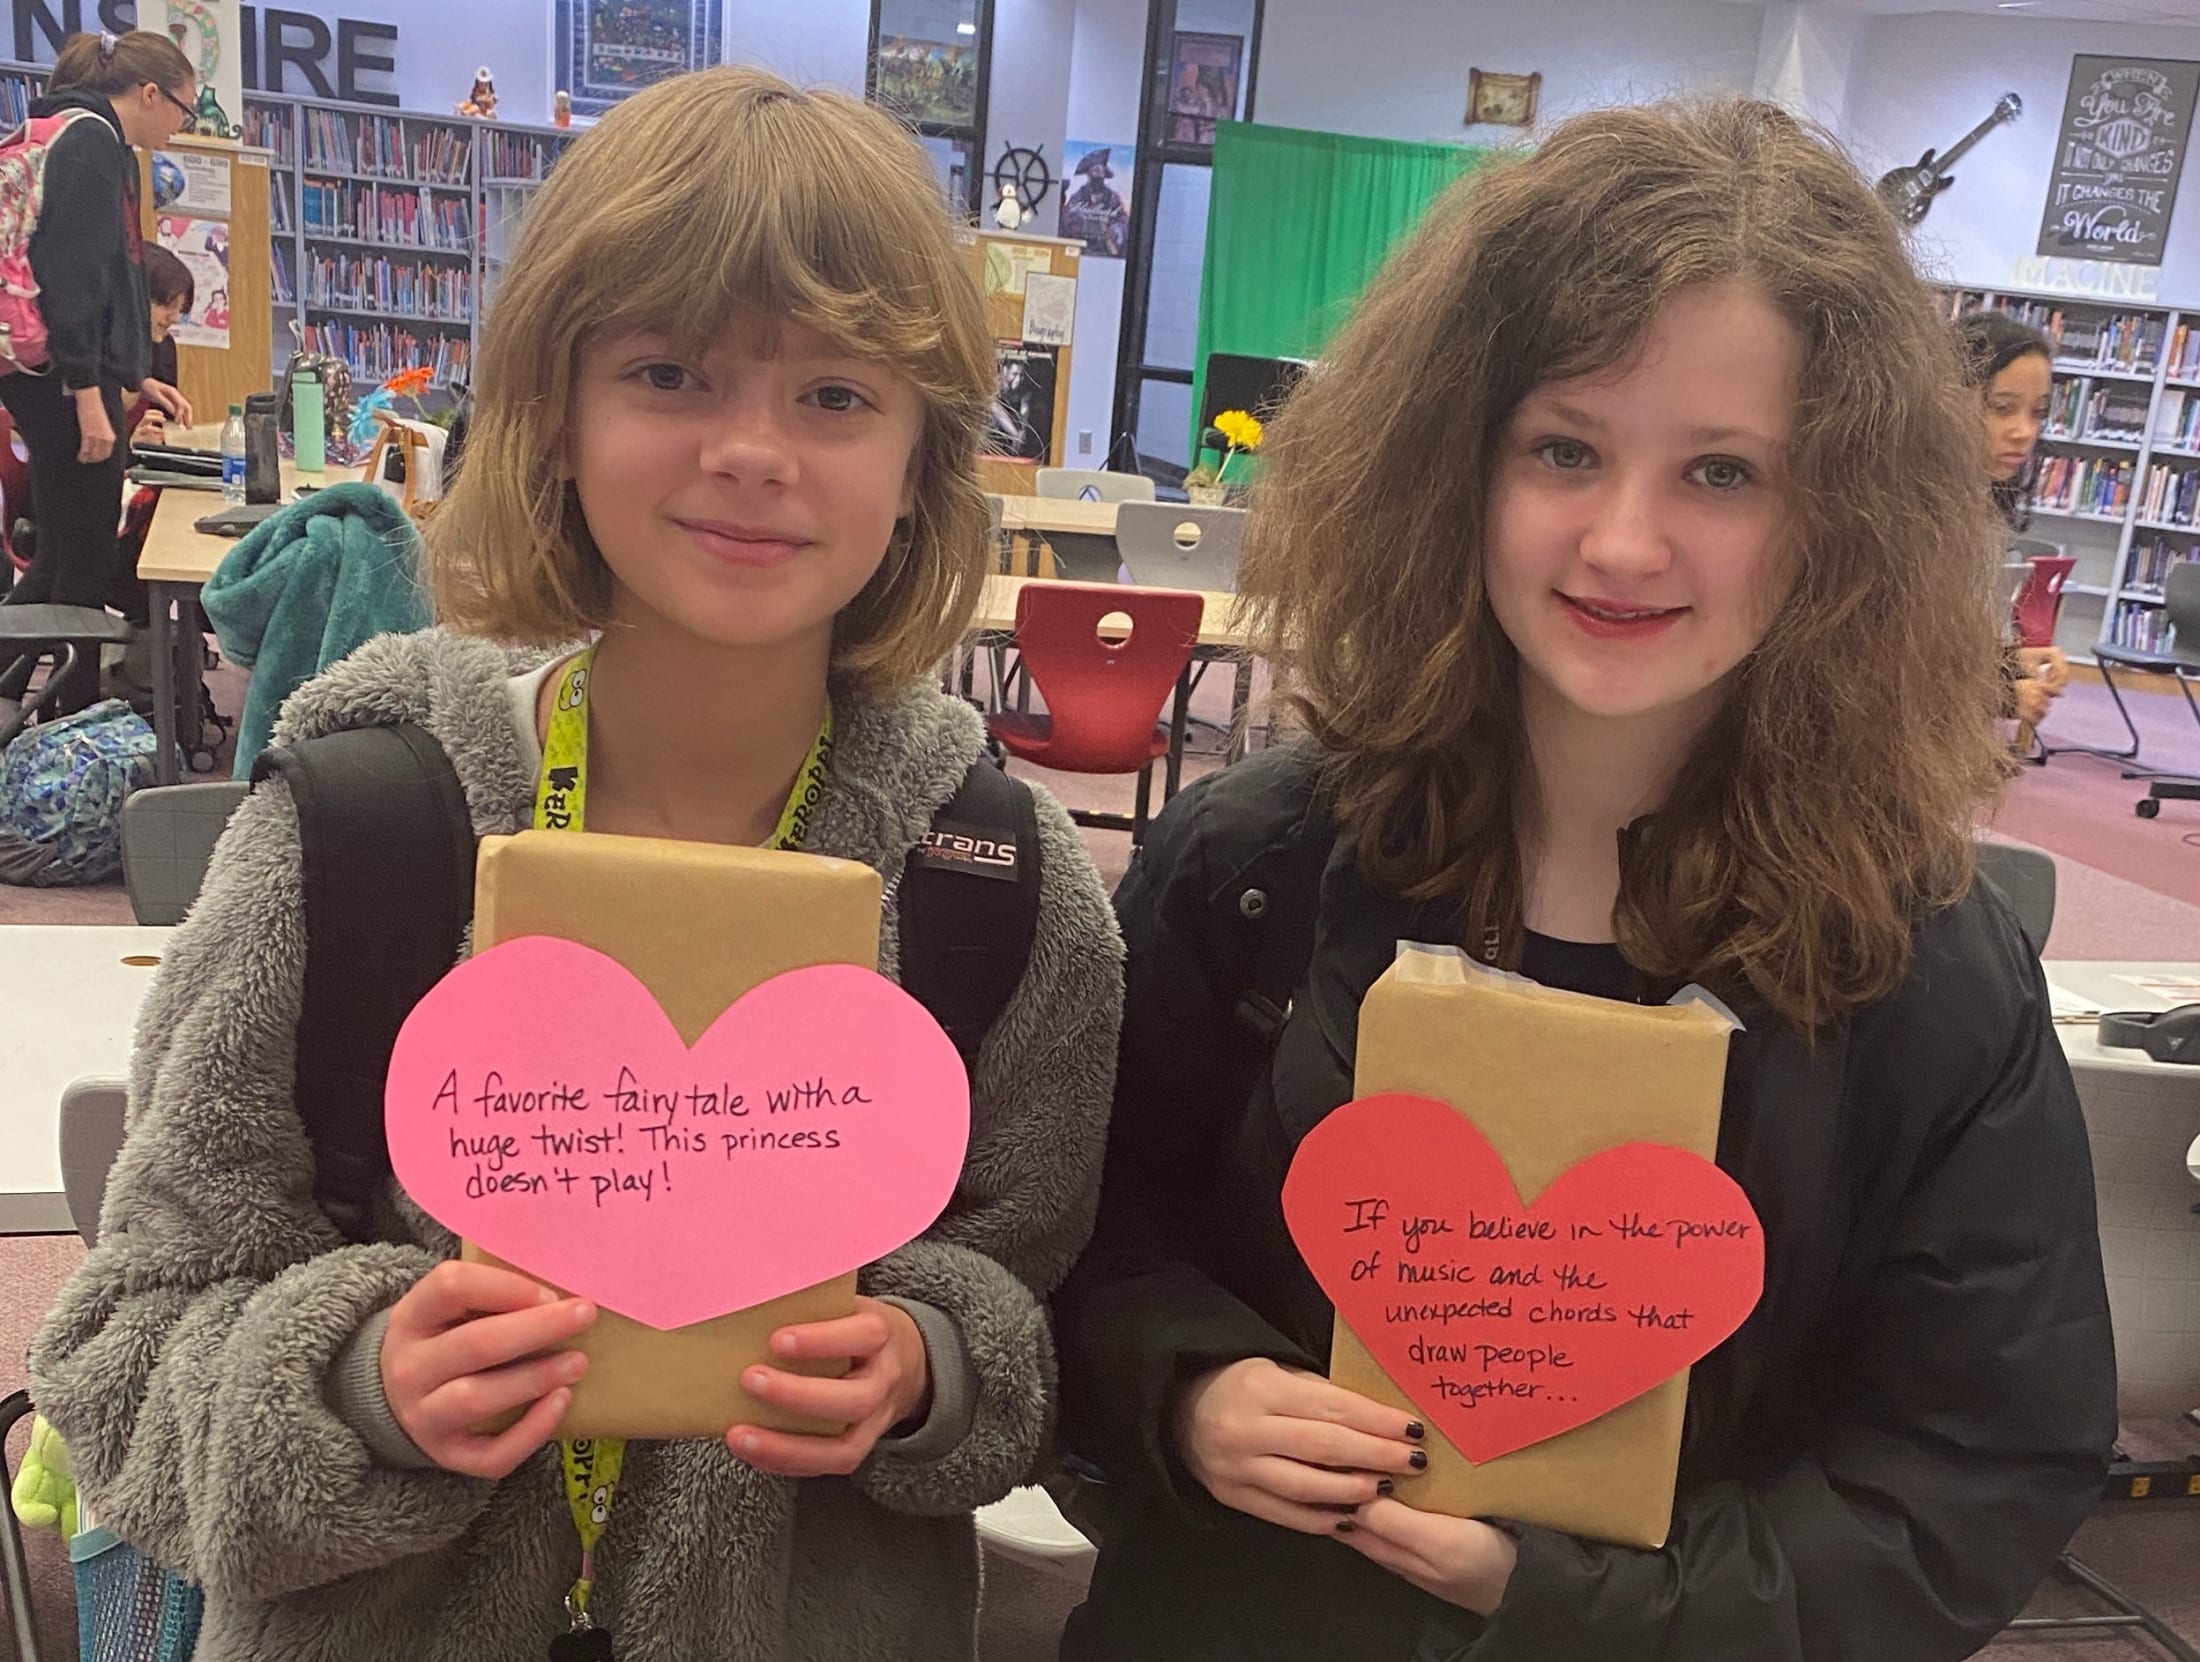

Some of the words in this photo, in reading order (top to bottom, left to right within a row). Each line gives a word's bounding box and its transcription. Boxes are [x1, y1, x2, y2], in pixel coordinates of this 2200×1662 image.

[2073, 92, 2127, 127] You
[2132, 92, 2176, 127] Are
[2097, 122, 2146, 155] KIND
[2137, 189, 2166, 214] THE
[2063, 204, 2145, 244] World
[432, 1068, 458, 1115] A
[473, 1071, 589, 1117] favorite
[449, 1127, 519, 1171] huge
[530, 1122, 624, 1156] twist!
[638, 1125, 706, 1152] This
[720, 1127, 840, 1160] princess
[465, 1163, 579, 1199] doesn't
[590, 1160, 672, 1208] play!
[1343, 1198, 1389, 1233] If
[1402, 1216, 1453, 1253] you
[1468, 1210, 1556, 1240] believe
[1570, 1222, 1604, 1241] in
[1608, 1212, 1664, 1240] the
[1666, 1219, 1751, 1249] power
[1350, 1250, 1381, 1281] of
[1397, 1259, 1476, 1284] music
[1489, 1263, 1543, 1286] and
[1553, 1263, 1608, 1291] the
[1385, 1297, 1513, 1326] unexpected
[1528, 1299, 1617, 1324] chords
[1627, 1304, 1694, 1330] that
[1408, 1334, 1467, 1365] draw
[1474, 1344, 1574, 1373] people
[1430, 1375, 1577, 1408] together...
